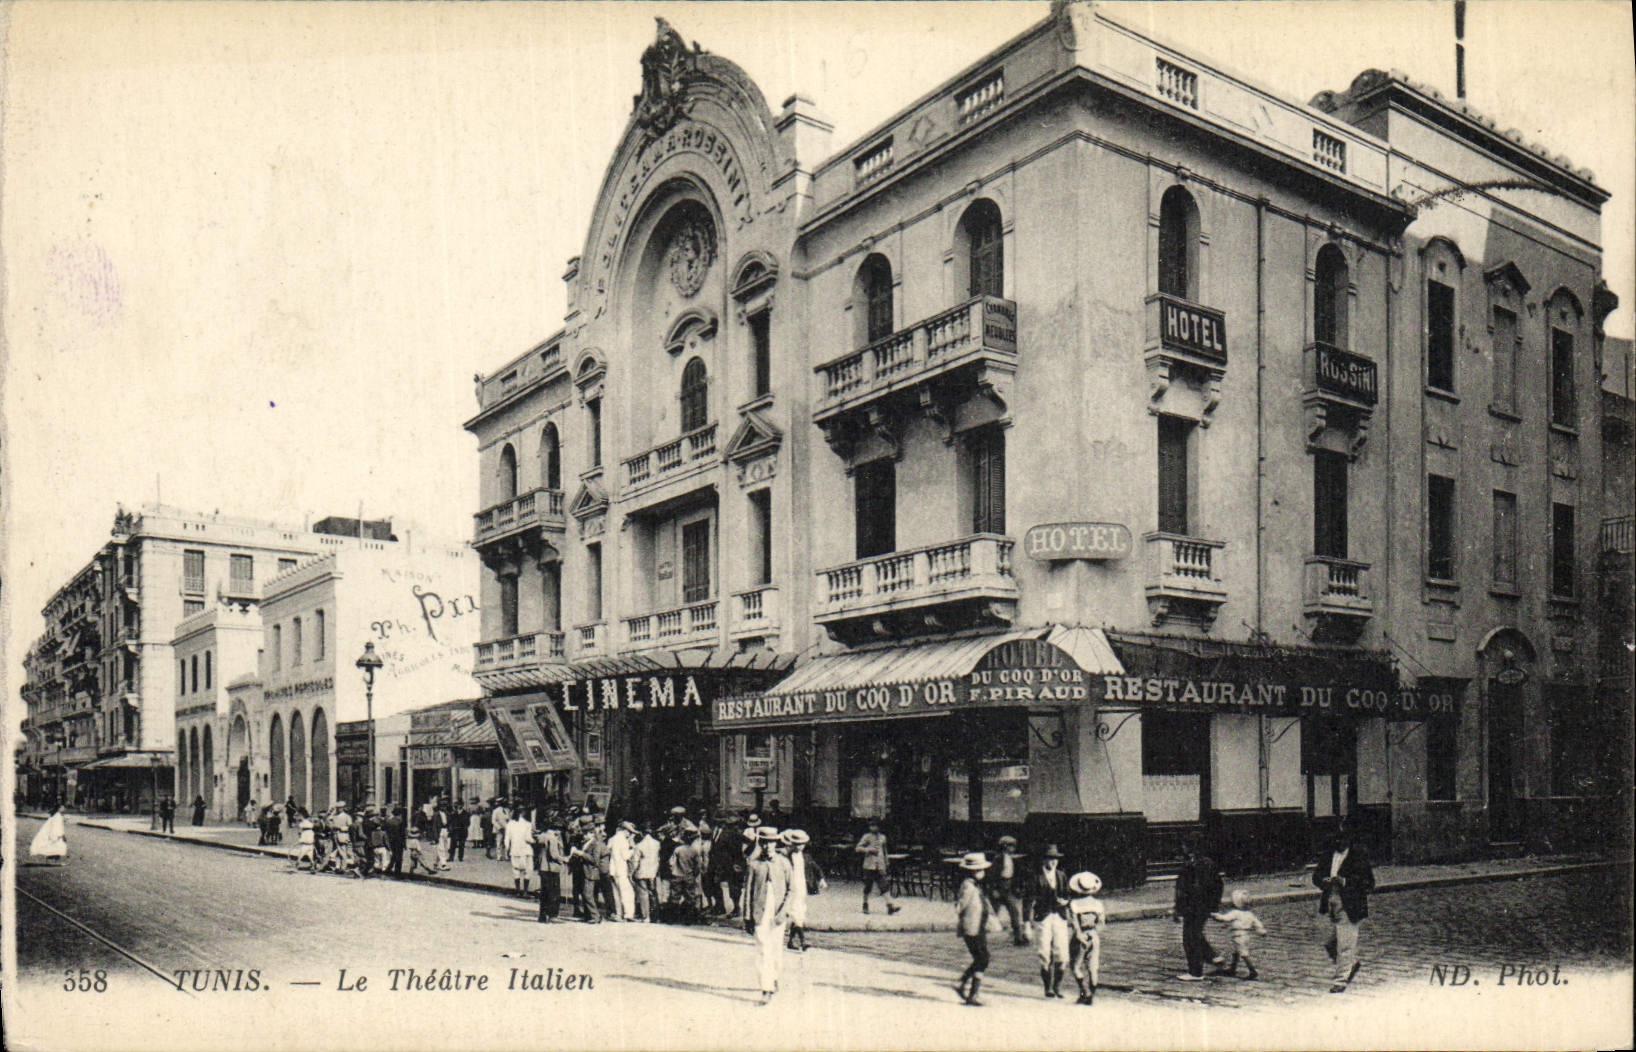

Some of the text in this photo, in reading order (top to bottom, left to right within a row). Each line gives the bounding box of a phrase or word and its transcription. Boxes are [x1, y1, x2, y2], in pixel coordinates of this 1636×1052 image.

[1167, 305, 1222, 351] HOTEL
[1320, 351, 1375, 393] ROSSINI
[1030, 526, 1127, 554] HOTEL
[986, 640, 1063, 668] HOTEL
[562, 675, 703, 712] CINEMA
[971, 668, 1083, 686] DU COQ D'OR
[1103, 676, 1286, 706] RESTAURANT
[1300, 686, 1332, 708] DU
[1346, 689, 1388, 713] COQ
[718, 681, 956, 721] RESTAURANT DU COQ D'OR
